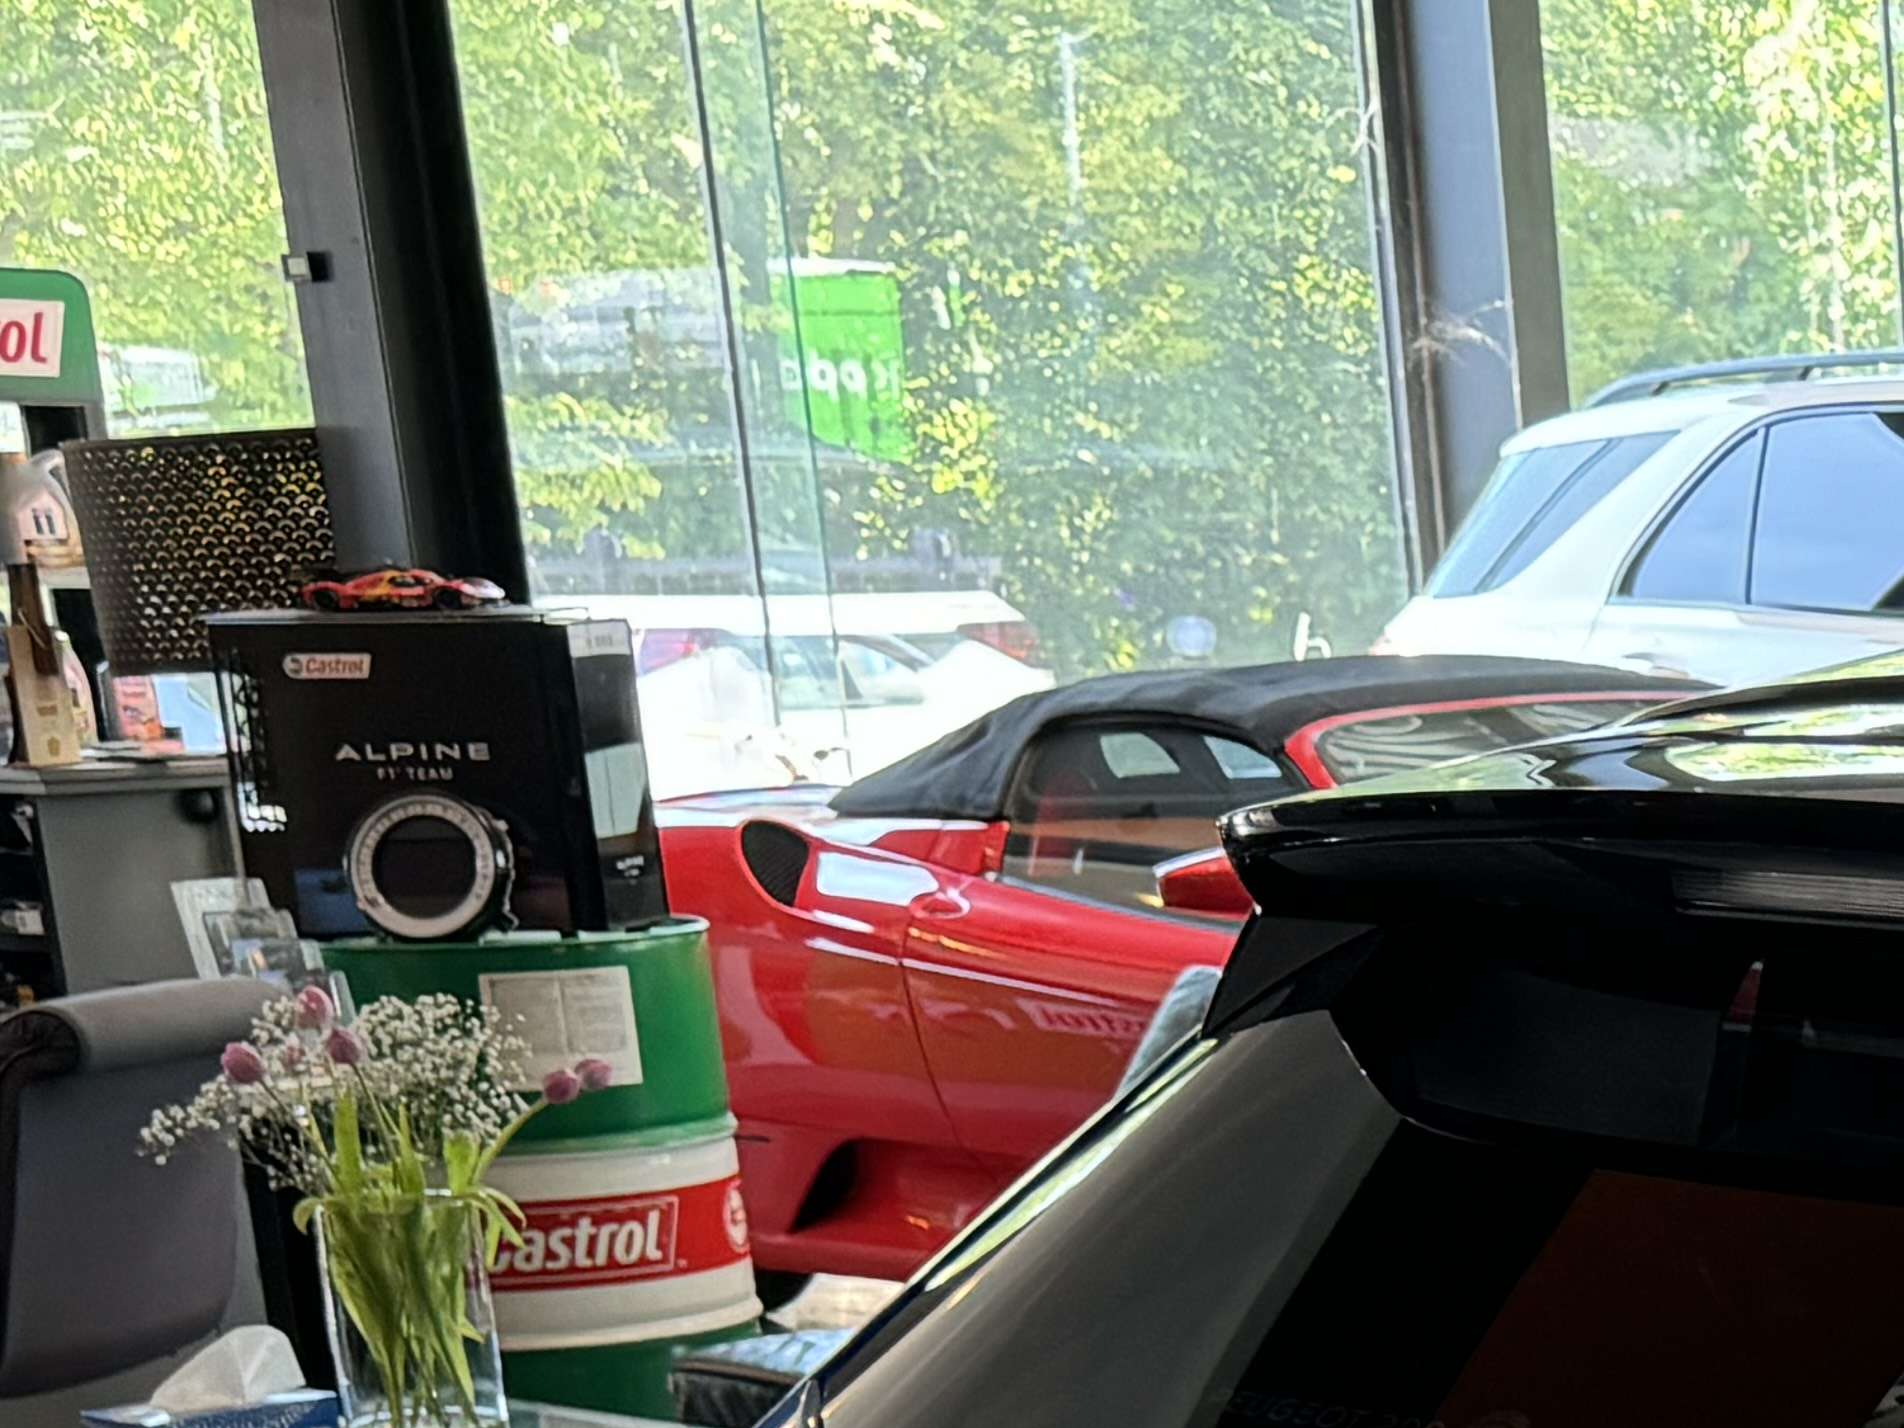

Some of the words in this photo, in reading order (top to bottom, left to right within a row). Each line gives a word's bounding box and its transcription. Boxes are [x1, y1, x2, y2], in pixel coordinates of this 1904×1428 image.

[0, 311, 48, 364] ol
[305, 656, 365, 674] Castrol
[335, 742, 490, 761] ALPINE
[405, 766, 454, 781] TEAM
